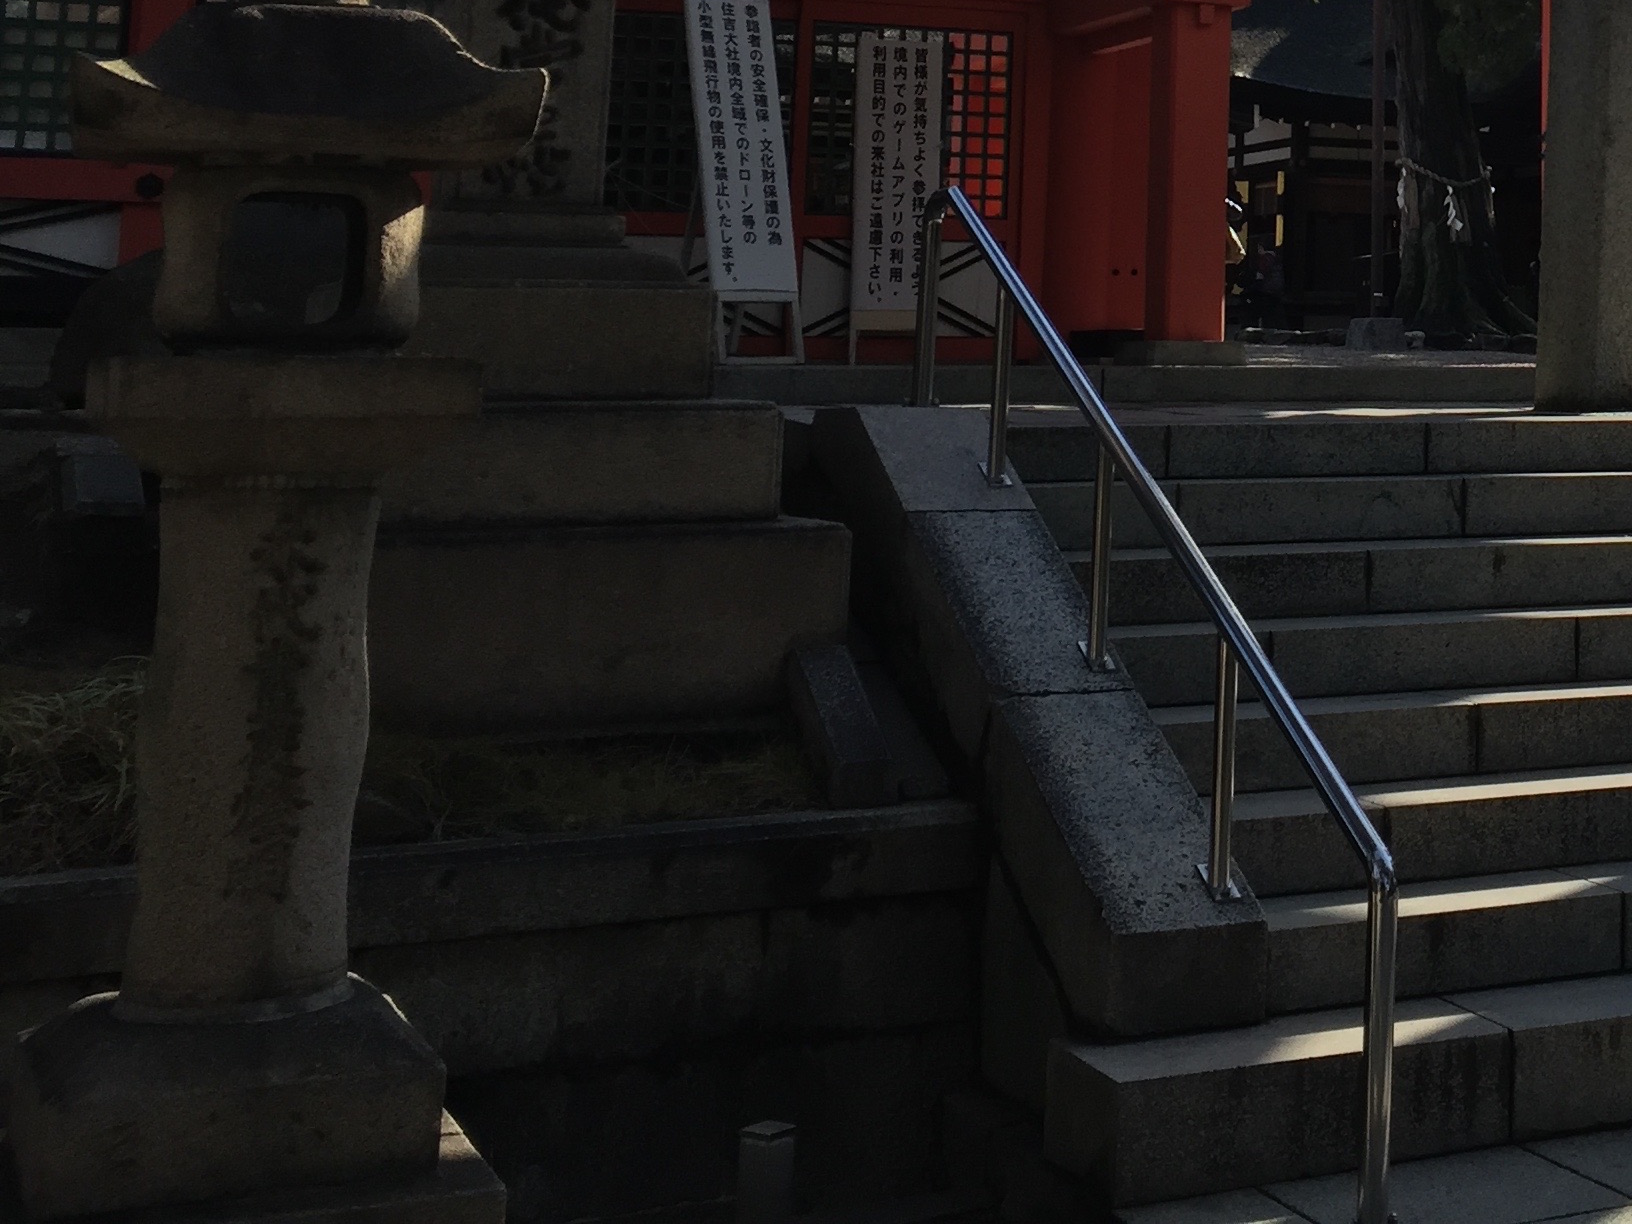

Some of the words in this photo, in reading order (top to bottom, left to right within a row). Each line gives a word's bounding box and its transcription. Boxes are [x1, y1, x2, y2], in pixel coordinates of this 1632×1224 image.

[721, 2, 757, 245] 住吉大社境内全域でのドローン等の
[868, 45, 887, 303] 利用目的での来社はご遠慮下さい。
